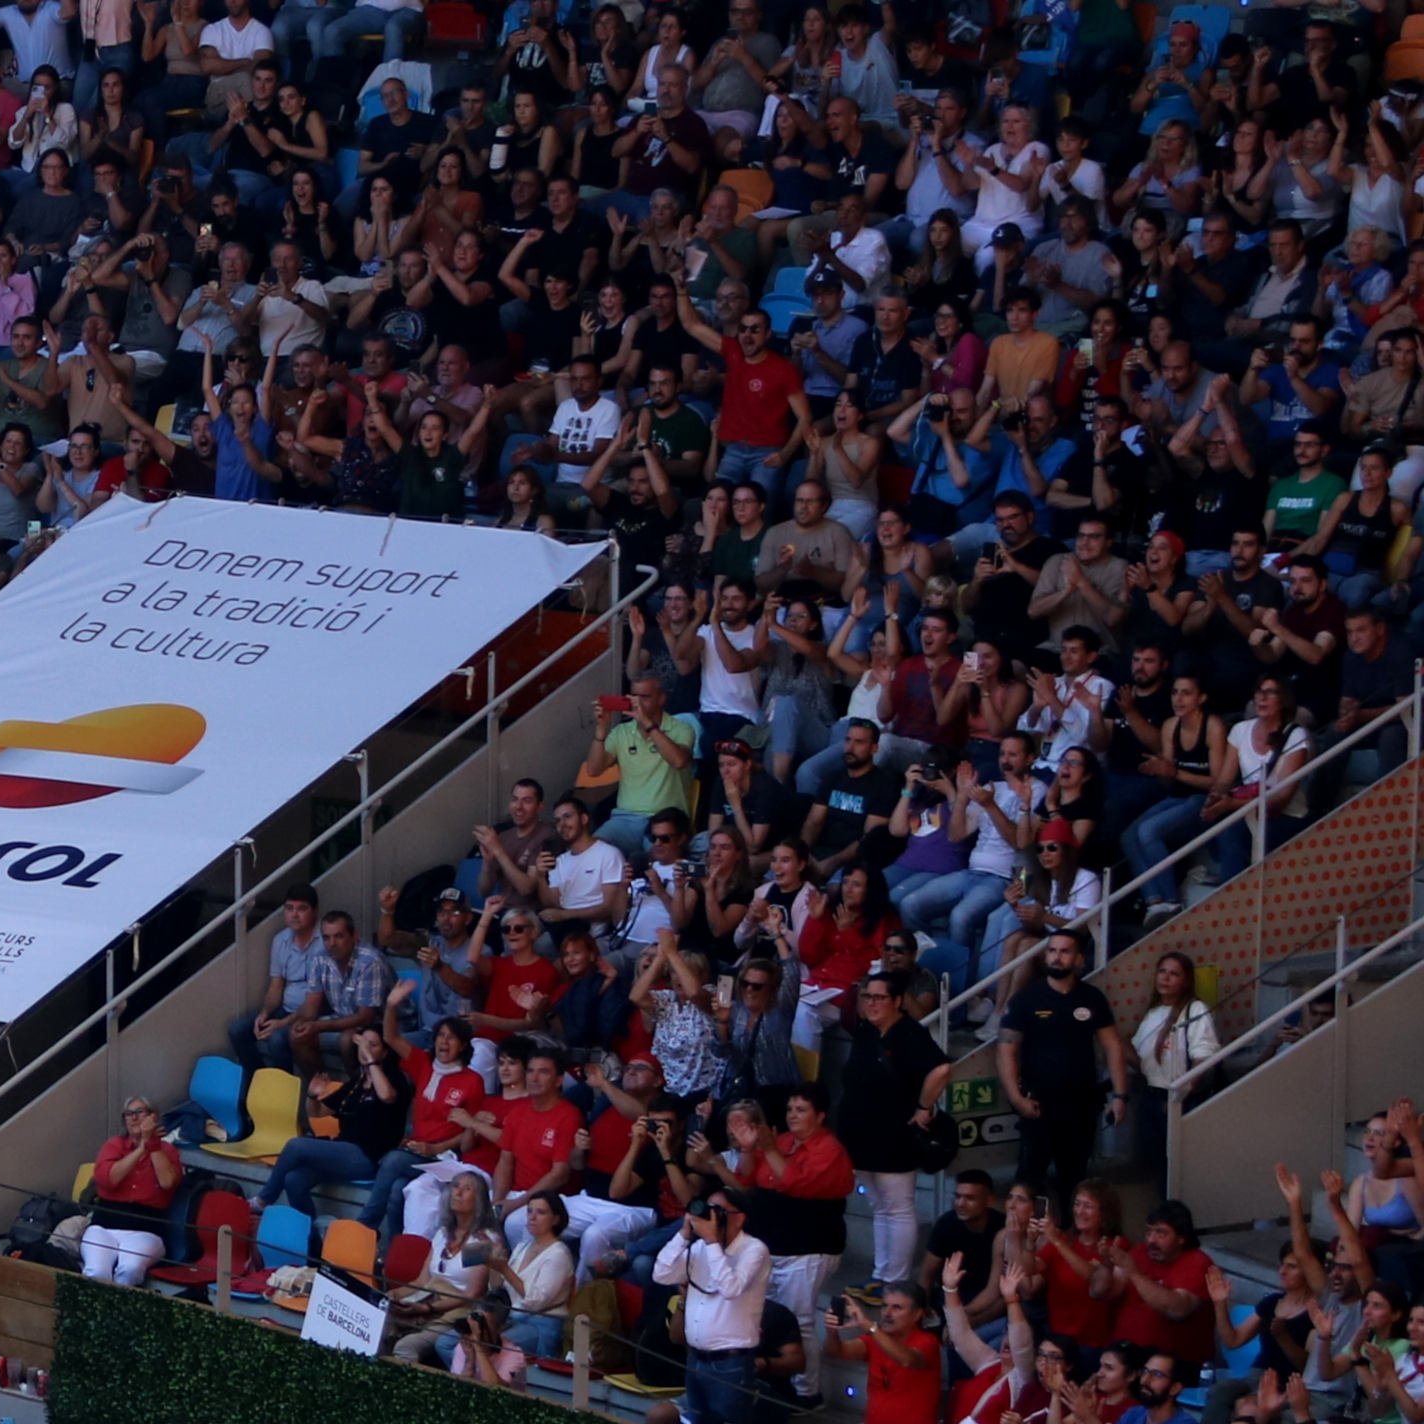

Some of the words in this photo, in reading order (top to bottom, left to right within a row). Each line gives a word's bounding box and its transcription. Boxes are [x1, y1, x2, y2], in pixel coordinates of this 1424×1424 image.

[144, 539, 303, 584] Donem
[306, 561, 460, 600] suport
[101, 582, 136, 604] a
[147, 580, 182, 612] la
[193, 586, 368, 632] tradició
[370, 606, 393, 634] i
[59, 612, 103, 643] la
[110, 625, 270, 666] cultura
[316, 1303, 327, 1318] DE
[327, 1310, 371, 1344] BARCELONA
[323, 1294, 370, 1329] CASTELLERS
